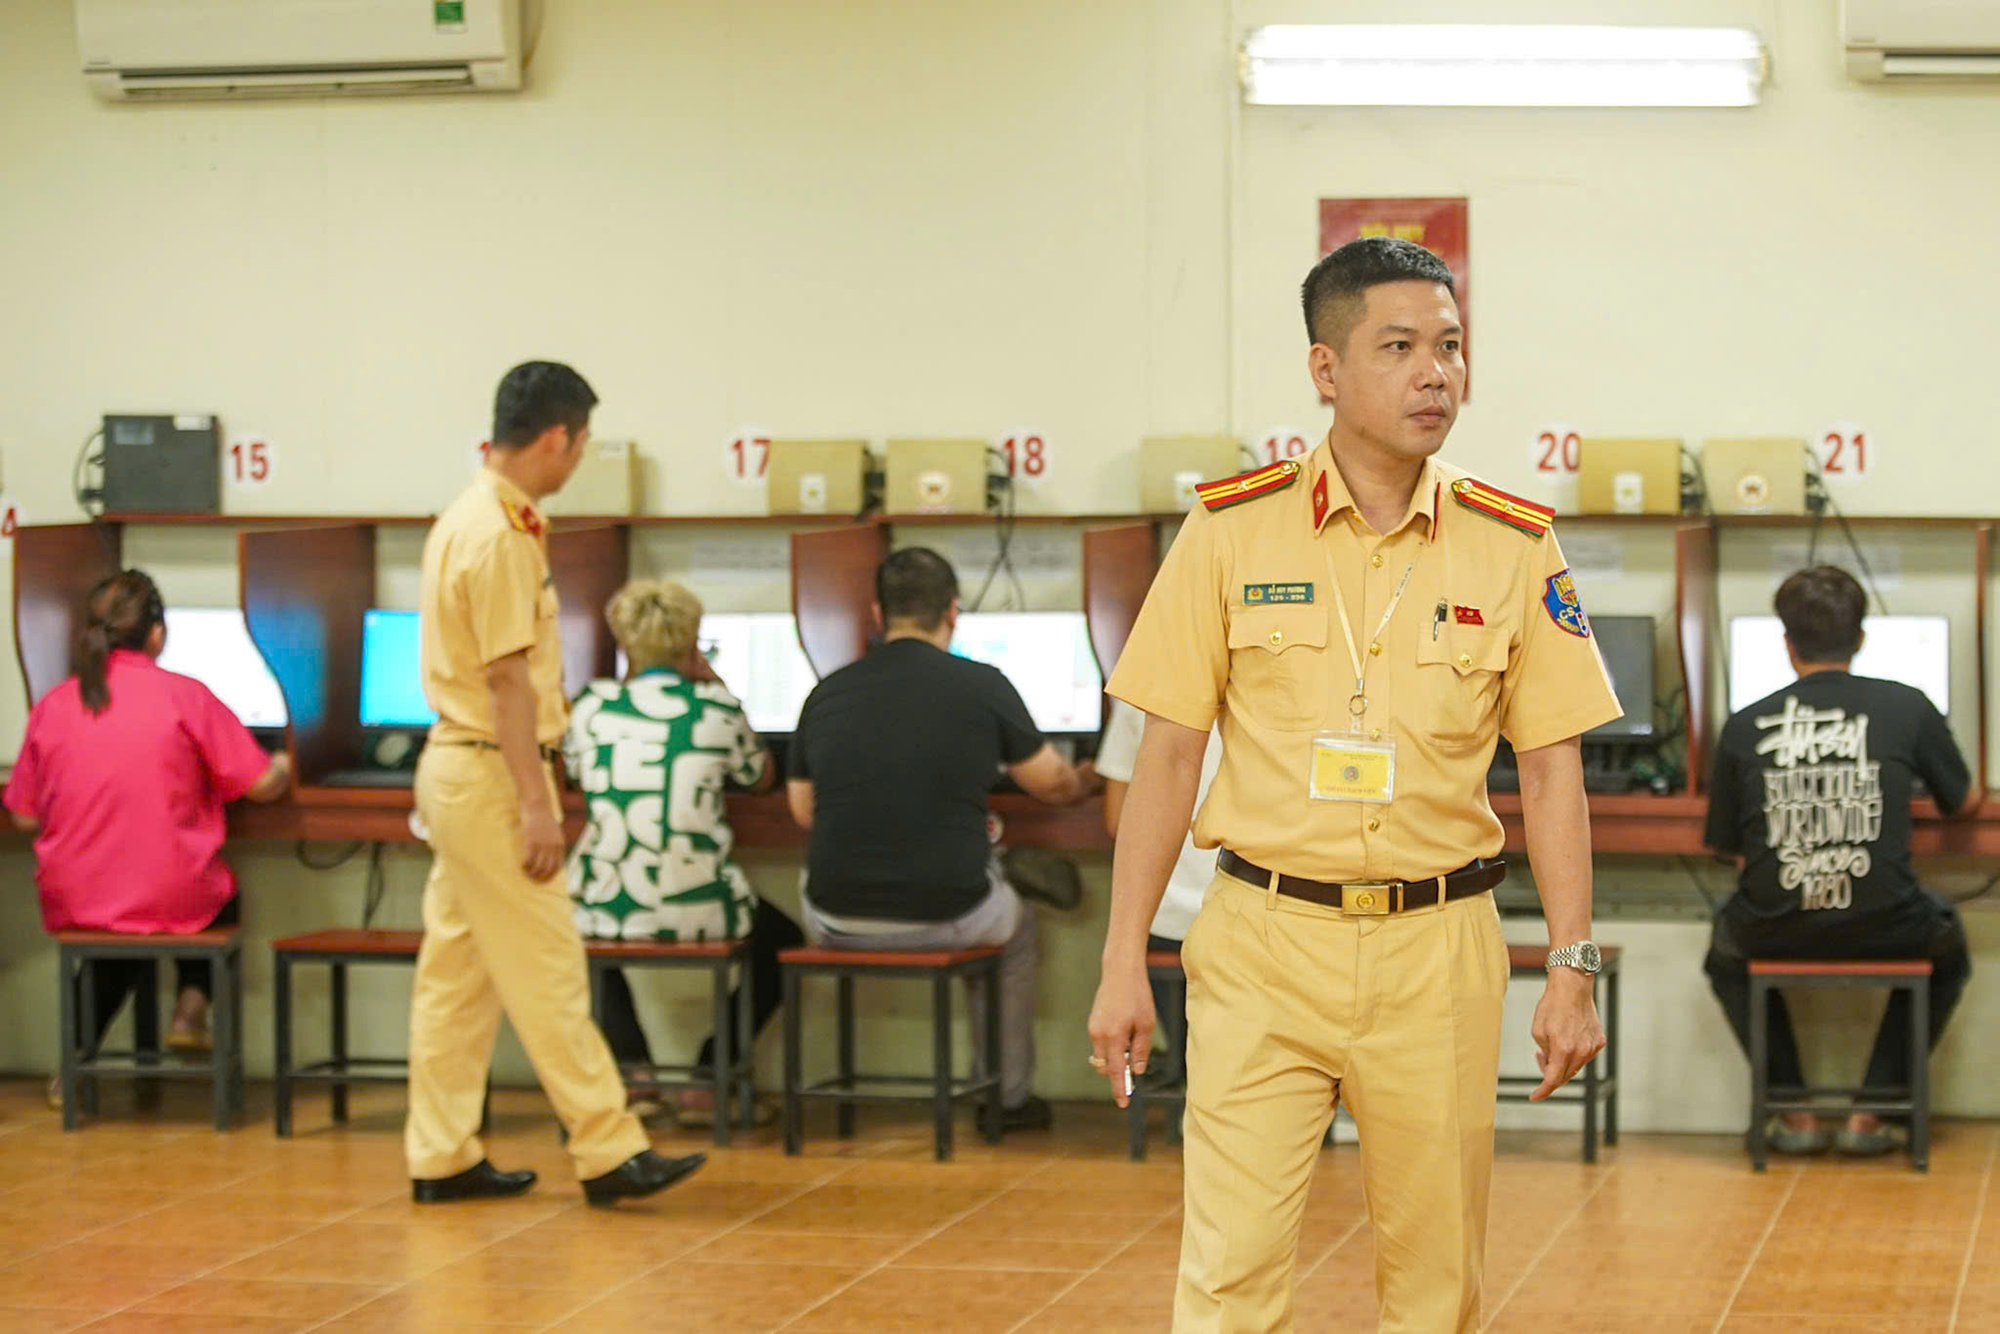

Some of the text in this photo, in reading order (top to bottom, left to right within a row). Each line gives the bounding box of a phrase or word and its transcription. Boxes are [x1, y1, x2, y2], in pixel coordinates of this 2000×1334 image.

[230, 443, 270, 481] 15
[732, 438, 772, 478] 17
[1003, 436, 1045, 476] 18
[1537, 432, 1582, 472] 20
[1824, 433, 1866, 473] 21
